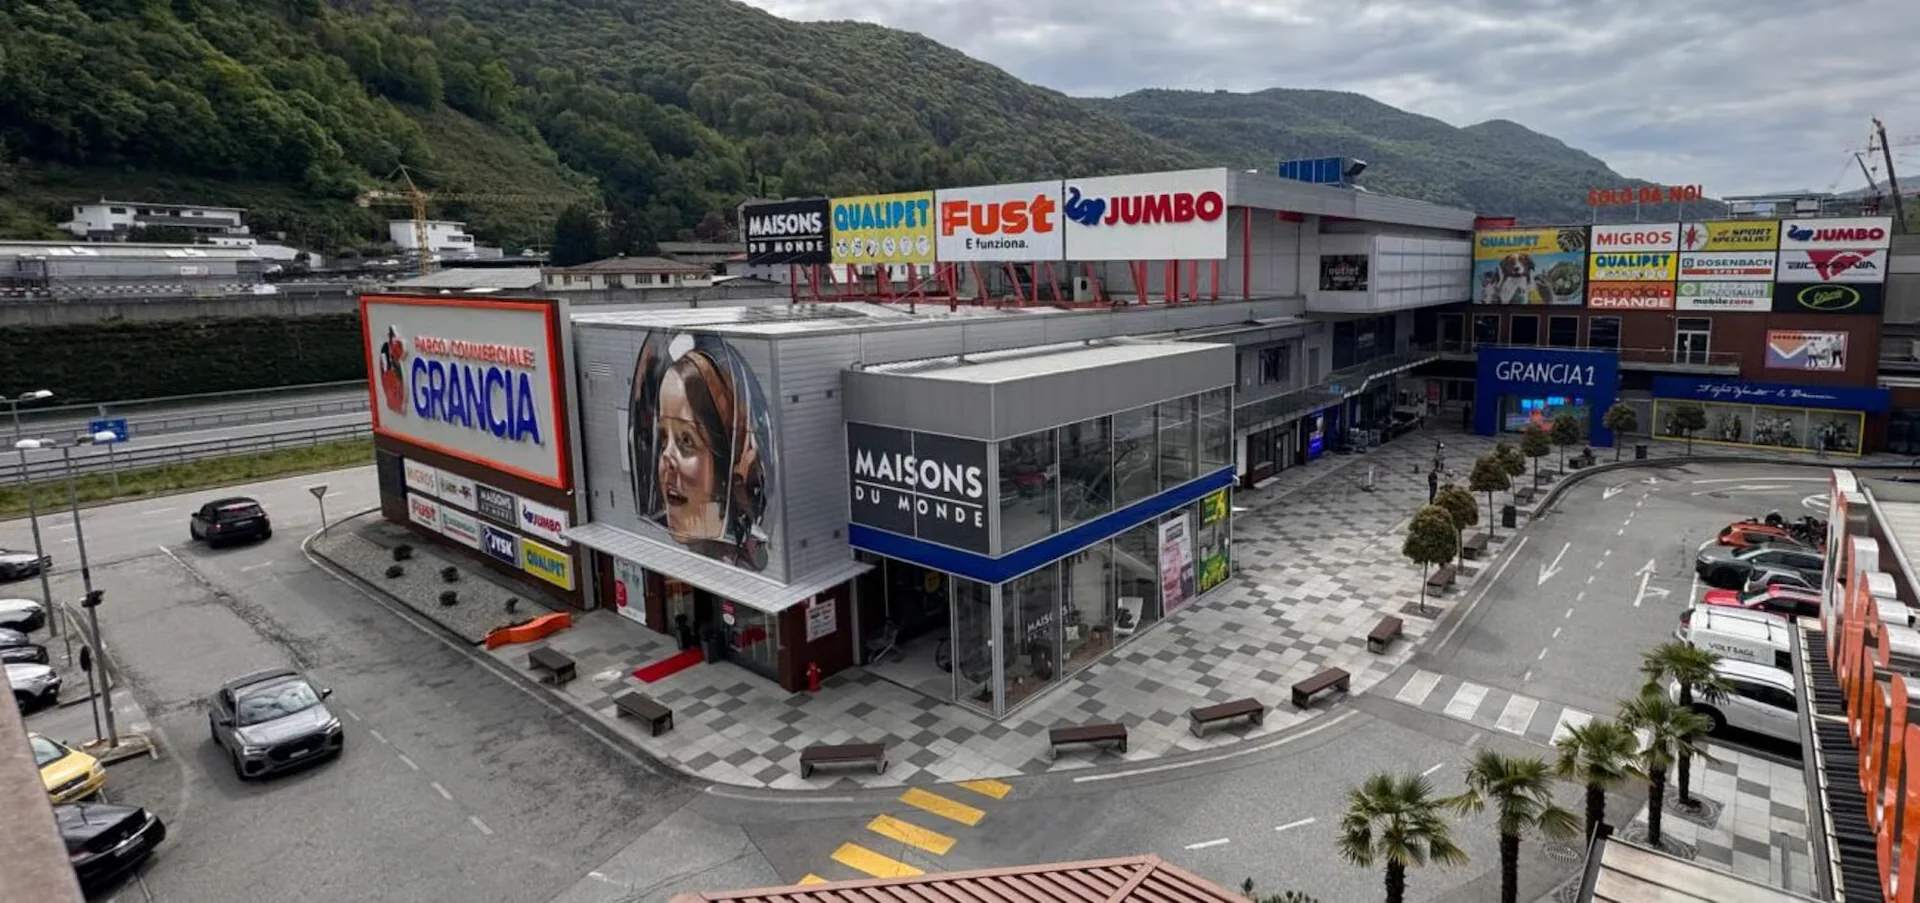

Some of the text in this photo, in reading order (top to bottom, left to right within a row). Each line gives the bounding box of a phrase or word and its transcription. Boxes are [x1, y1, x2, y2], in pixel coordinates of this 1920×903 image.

[1588, 187, 1633, 207] SOLO
[1638, 186, 1663, 203] DA
[834, 199, 930, 231] QUALIPET
[941, 194, 1055, 236] Fust
[1105, 191, 1223, 226] JUMBO
[749, 212, 823, 235] MAISONS
[1733, 228, 1772, 236] SPORT
[1813, 227, 1884, 241] JUMBO
[750, 241, 824, 253] DU MONDE
[966, 236, 1029, 249] E funziona.
[1480, 235, 1540, 247] QUALIPET
[1596, 231, 1672, 246] MIGROS
[1596, 254, 1670, 267] QUALIPET
[1697, 259, 1773, 267] DOSENBACH
[1591, 297, 1670, 307] CHANGE
[414, 336, 535, 367] PARCO COMMERCIALE
[412, 356, 541, 445] GRANCIA
[855, 447, 982, 498] MAISONS
[855, 485, 982, 528] DU MONDE
[534, 513, 562, 533] JUMBO
[491, 533, 514, 558] JYSK
[526, 549, 565, 578] QUALIPET
